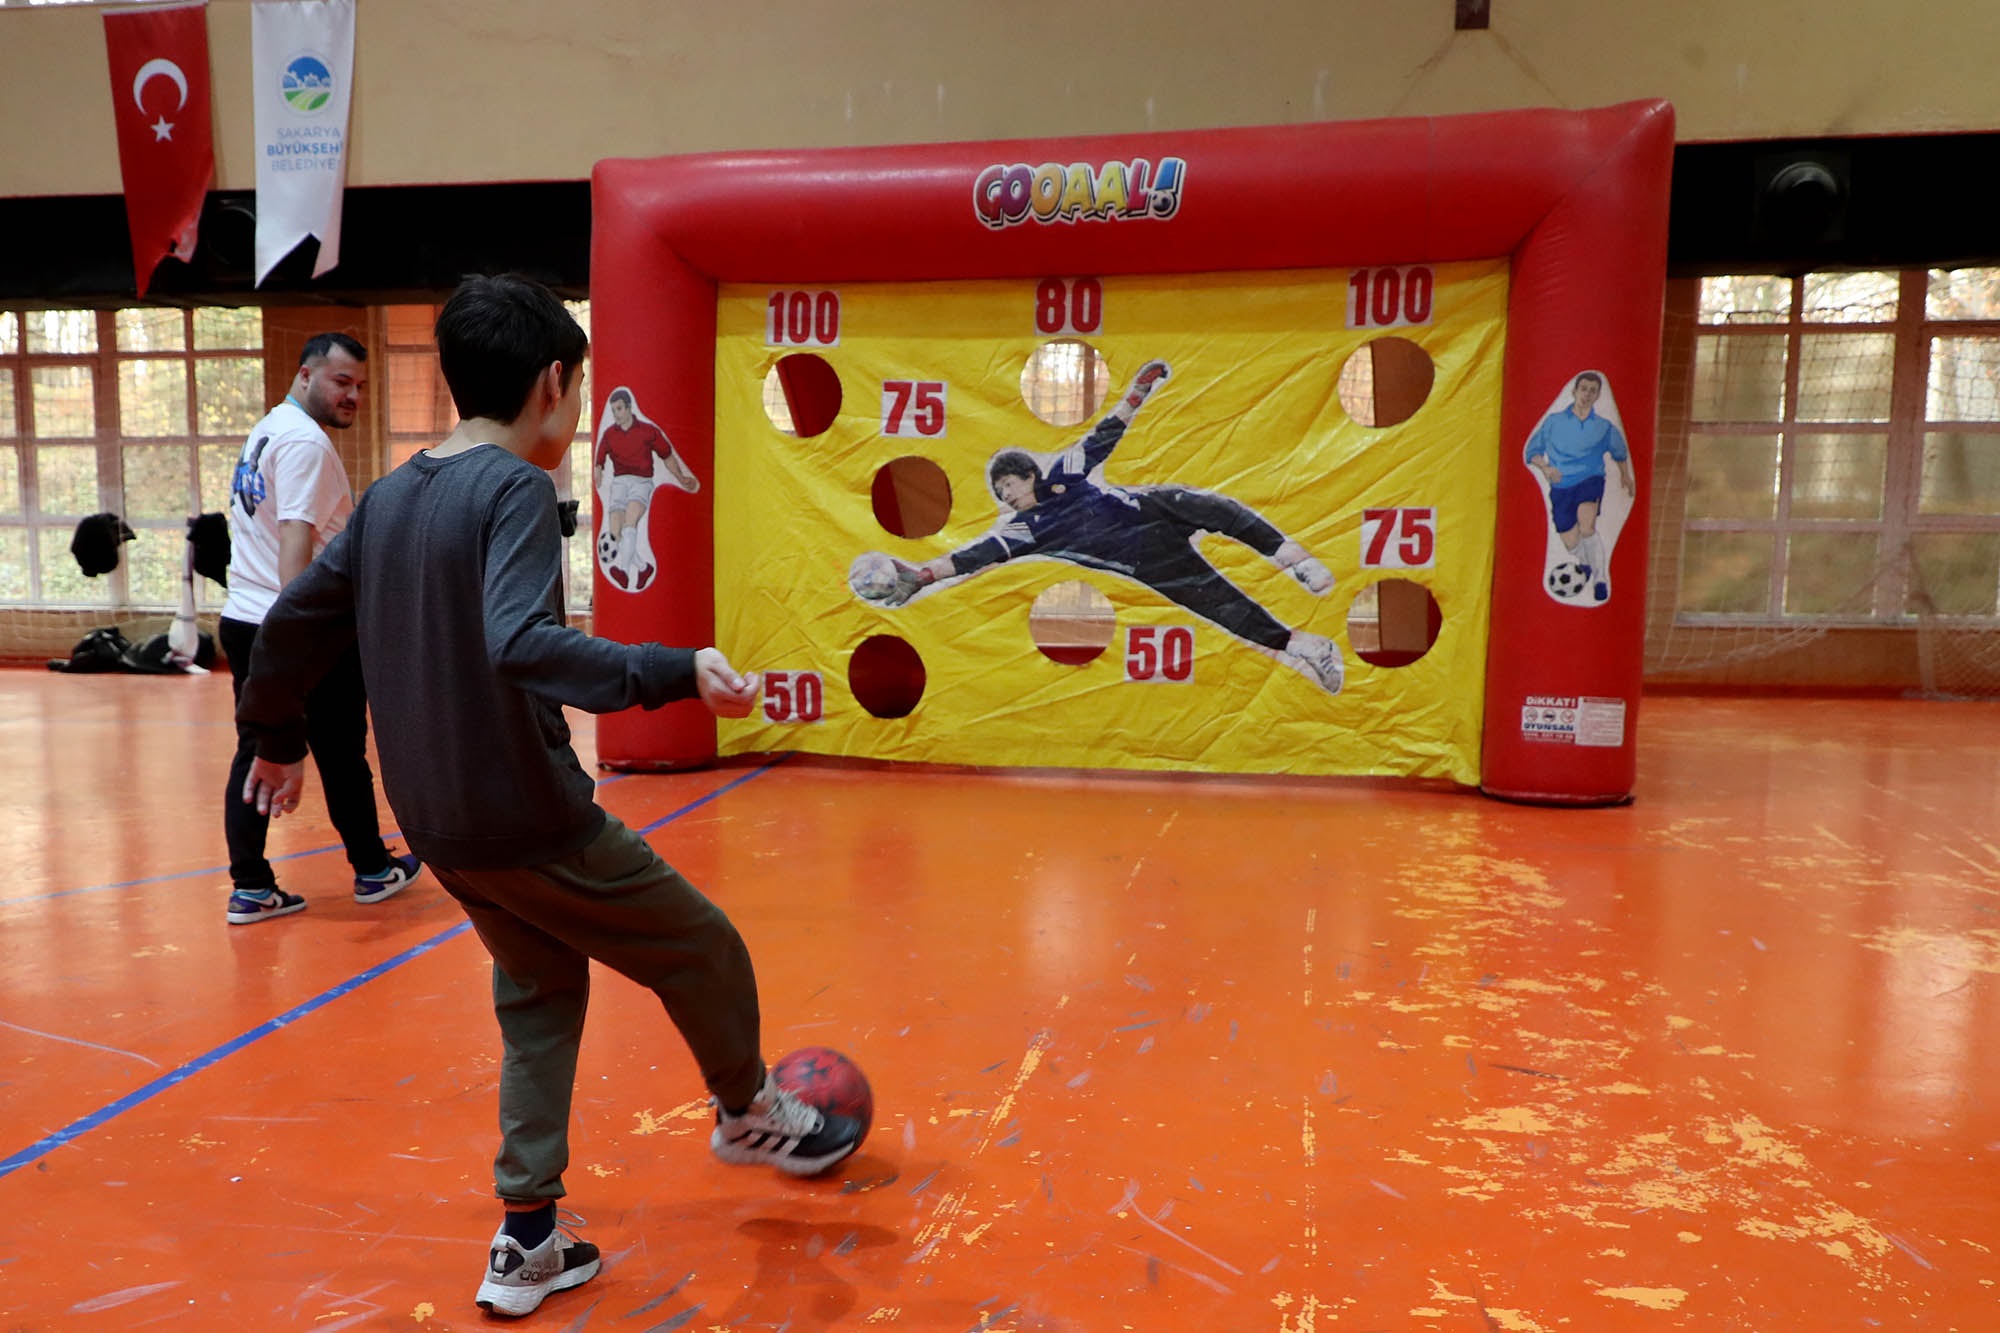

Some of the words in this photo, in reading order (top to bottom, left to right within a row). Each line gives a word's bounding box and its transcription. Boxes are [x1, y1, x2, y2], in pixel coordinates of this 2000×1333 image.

[266, 141, 343, 157] BÜYÜKŞEHİ
[277, 126, 341, 138] SAKARYA
[271, 158, 339, 171] BELEDİYE
[975, 158, 1186, 230] GOOAAL!
[768, 291, 839, 344] 100
[1036, 278, 1101, 333] 80
[1350, 266, 1433, 326] 100
[883, 381, 944, 435] 75
[1364, 509, 1433, 566] 75
[1127, 627, 1192, 681] 50
[763, 672, 822, 722] 50
